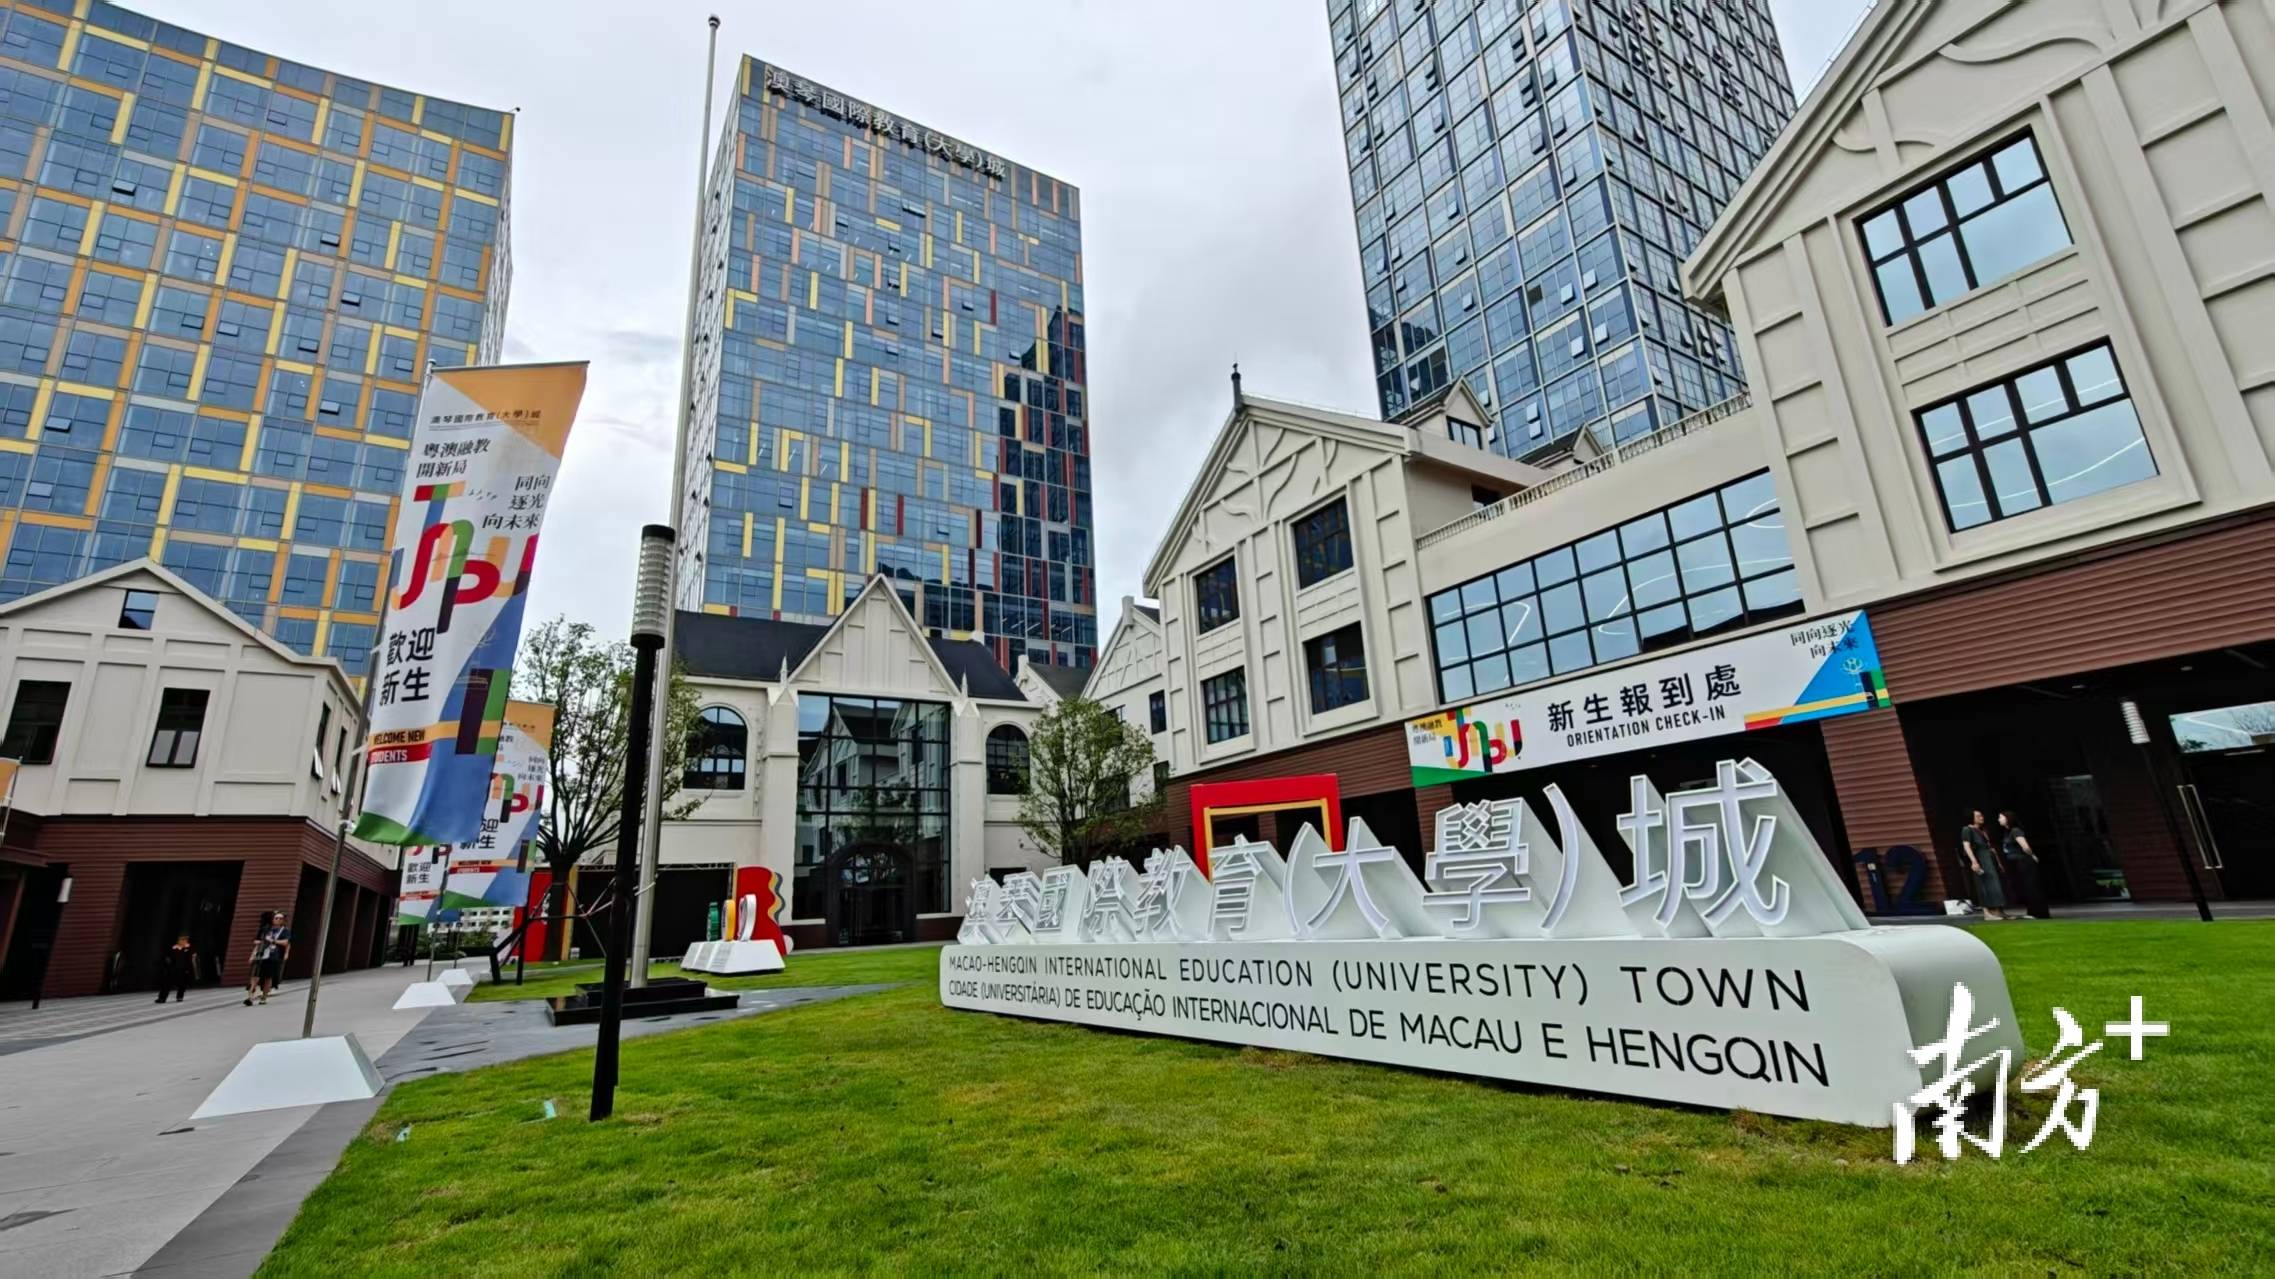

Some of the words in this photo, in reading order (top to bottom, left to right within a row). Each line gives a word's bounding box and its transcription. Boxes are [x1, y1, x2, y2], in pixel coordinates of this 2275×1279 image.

[766, 71, 1006, 179] 澳琴國際教育(大學)城
[423, 438, 491, 459] 粵澳融教
[416, 459, 467, 478] 開新局
[514, 475, 549, 491] 同向
[508, 493, 546, 511] 逐光
[482, 514, 539, 530] 向未來
[386, 627, 435, 666] 歡迎
[379, 666, 431, 707] 新生
[1548, 664, 1742, 734] 新生報到處
[408, 729, 425, 742] NEW
[1567, 721, 1650, 748] ORIENTATION
[1656, 708, 1726, 731] CHECK-IN
[481, 818, 498, 833] 迎
[957, 757, 1792, 944] 澳琴國際教育(大學)城
[1854, 845, 1937, 915] 12
[949, 955, 1038, 975] MACAO-HENGQIN
[1044, 956, 1166, 980] INTERNATIONAL
[1180, 959, 1313, 987] EDUCATION
[1332, 959, 1588, 1006] (UNIVERSITY)
[1620, 966, 1810, 1012] TOWN
[949, 981, 978, 998] CIDADE
[981, 979, 1060, 1009] (UNIVERSITÁRIA)
[1065, 988, 1081, 1008] DE
[1087, 988, 1166, 1021] EDUCAÇÃO
[1173, 995, 1338, 1035] INTERNACIONAL
[1350, 1008, 1387, 1040] DE
[1400, 1013, 1522, 1053] MACAU
[1542, 1022, 1567, 1059] E
[1586, 1026, 1829, 1087] HENGQIN
